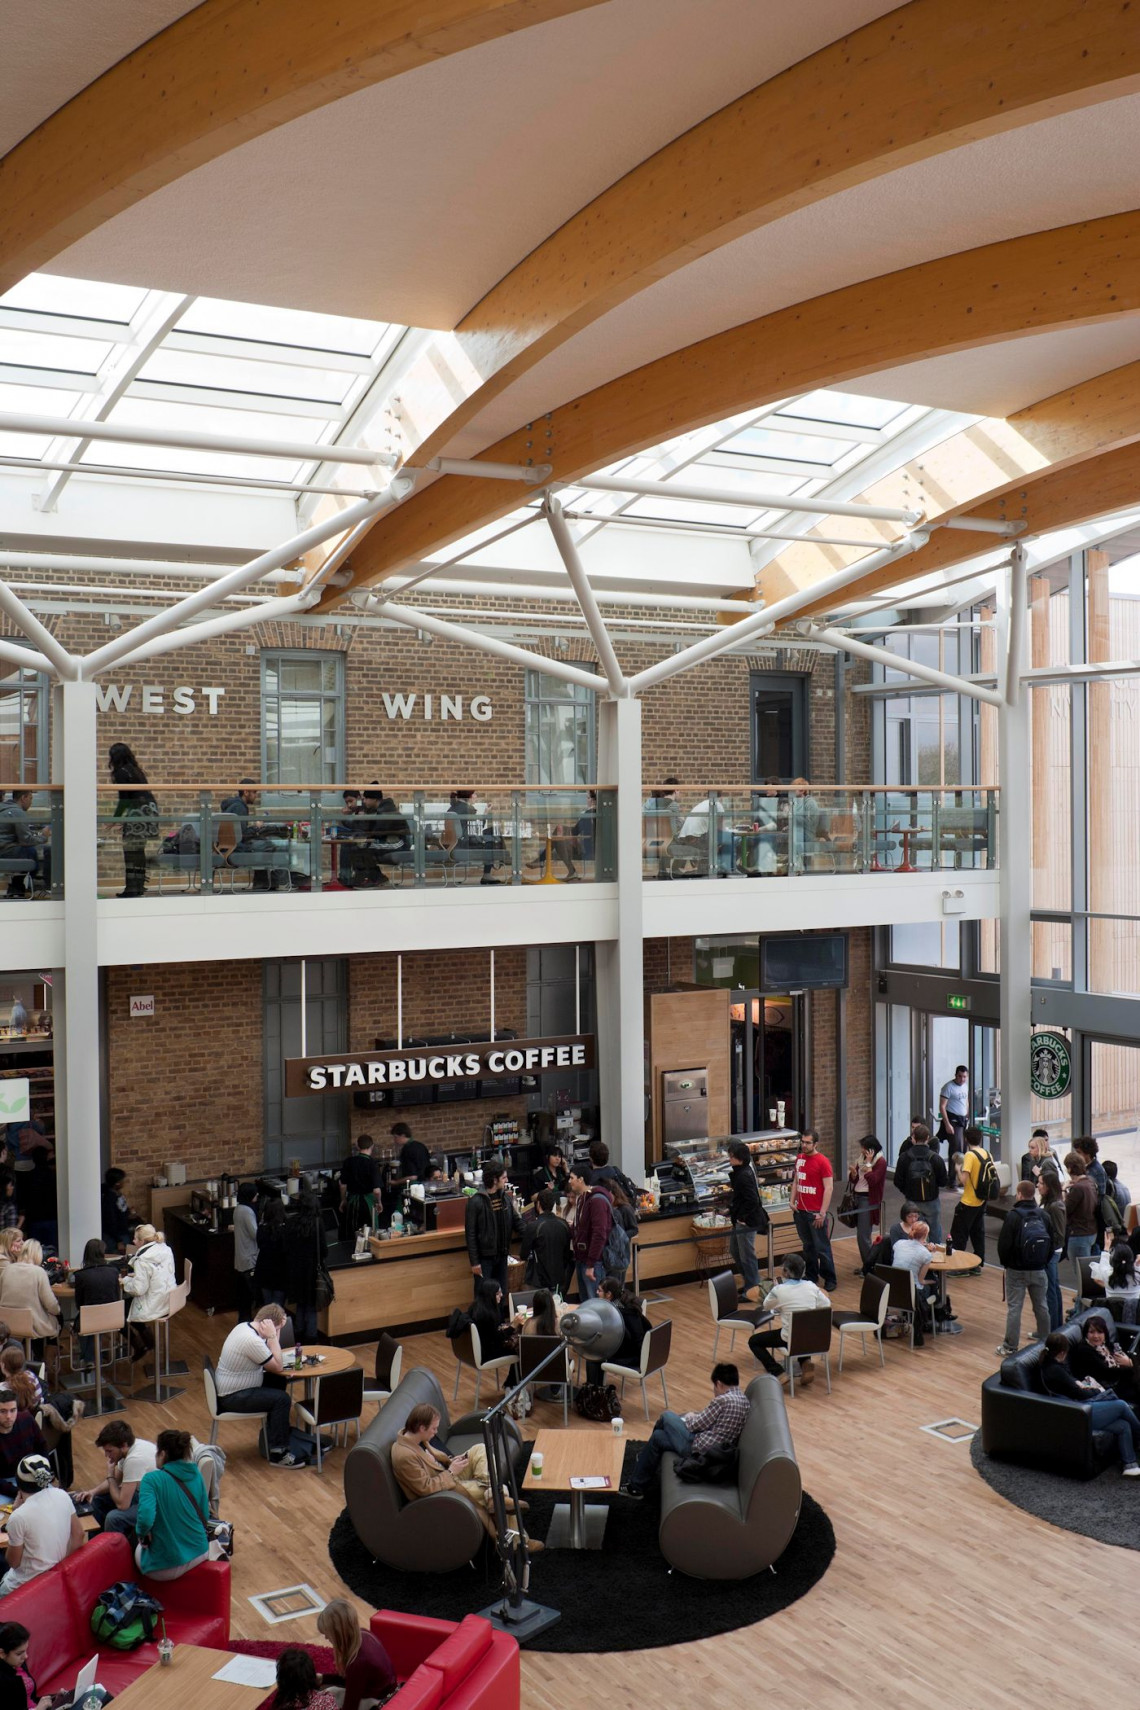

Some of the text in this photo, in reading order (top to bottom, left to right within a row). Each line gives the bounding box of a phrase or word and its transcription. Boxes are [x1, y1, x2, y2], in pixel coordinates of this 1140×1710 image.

[96, 684, 493, 722] WEST WING
[131, 1000, 154, 1012] Abel
[309, 1044, 586, 1090] STARBUCKS COFFEE
[1031, 1036, 1069, 1067] ARBUCKS
